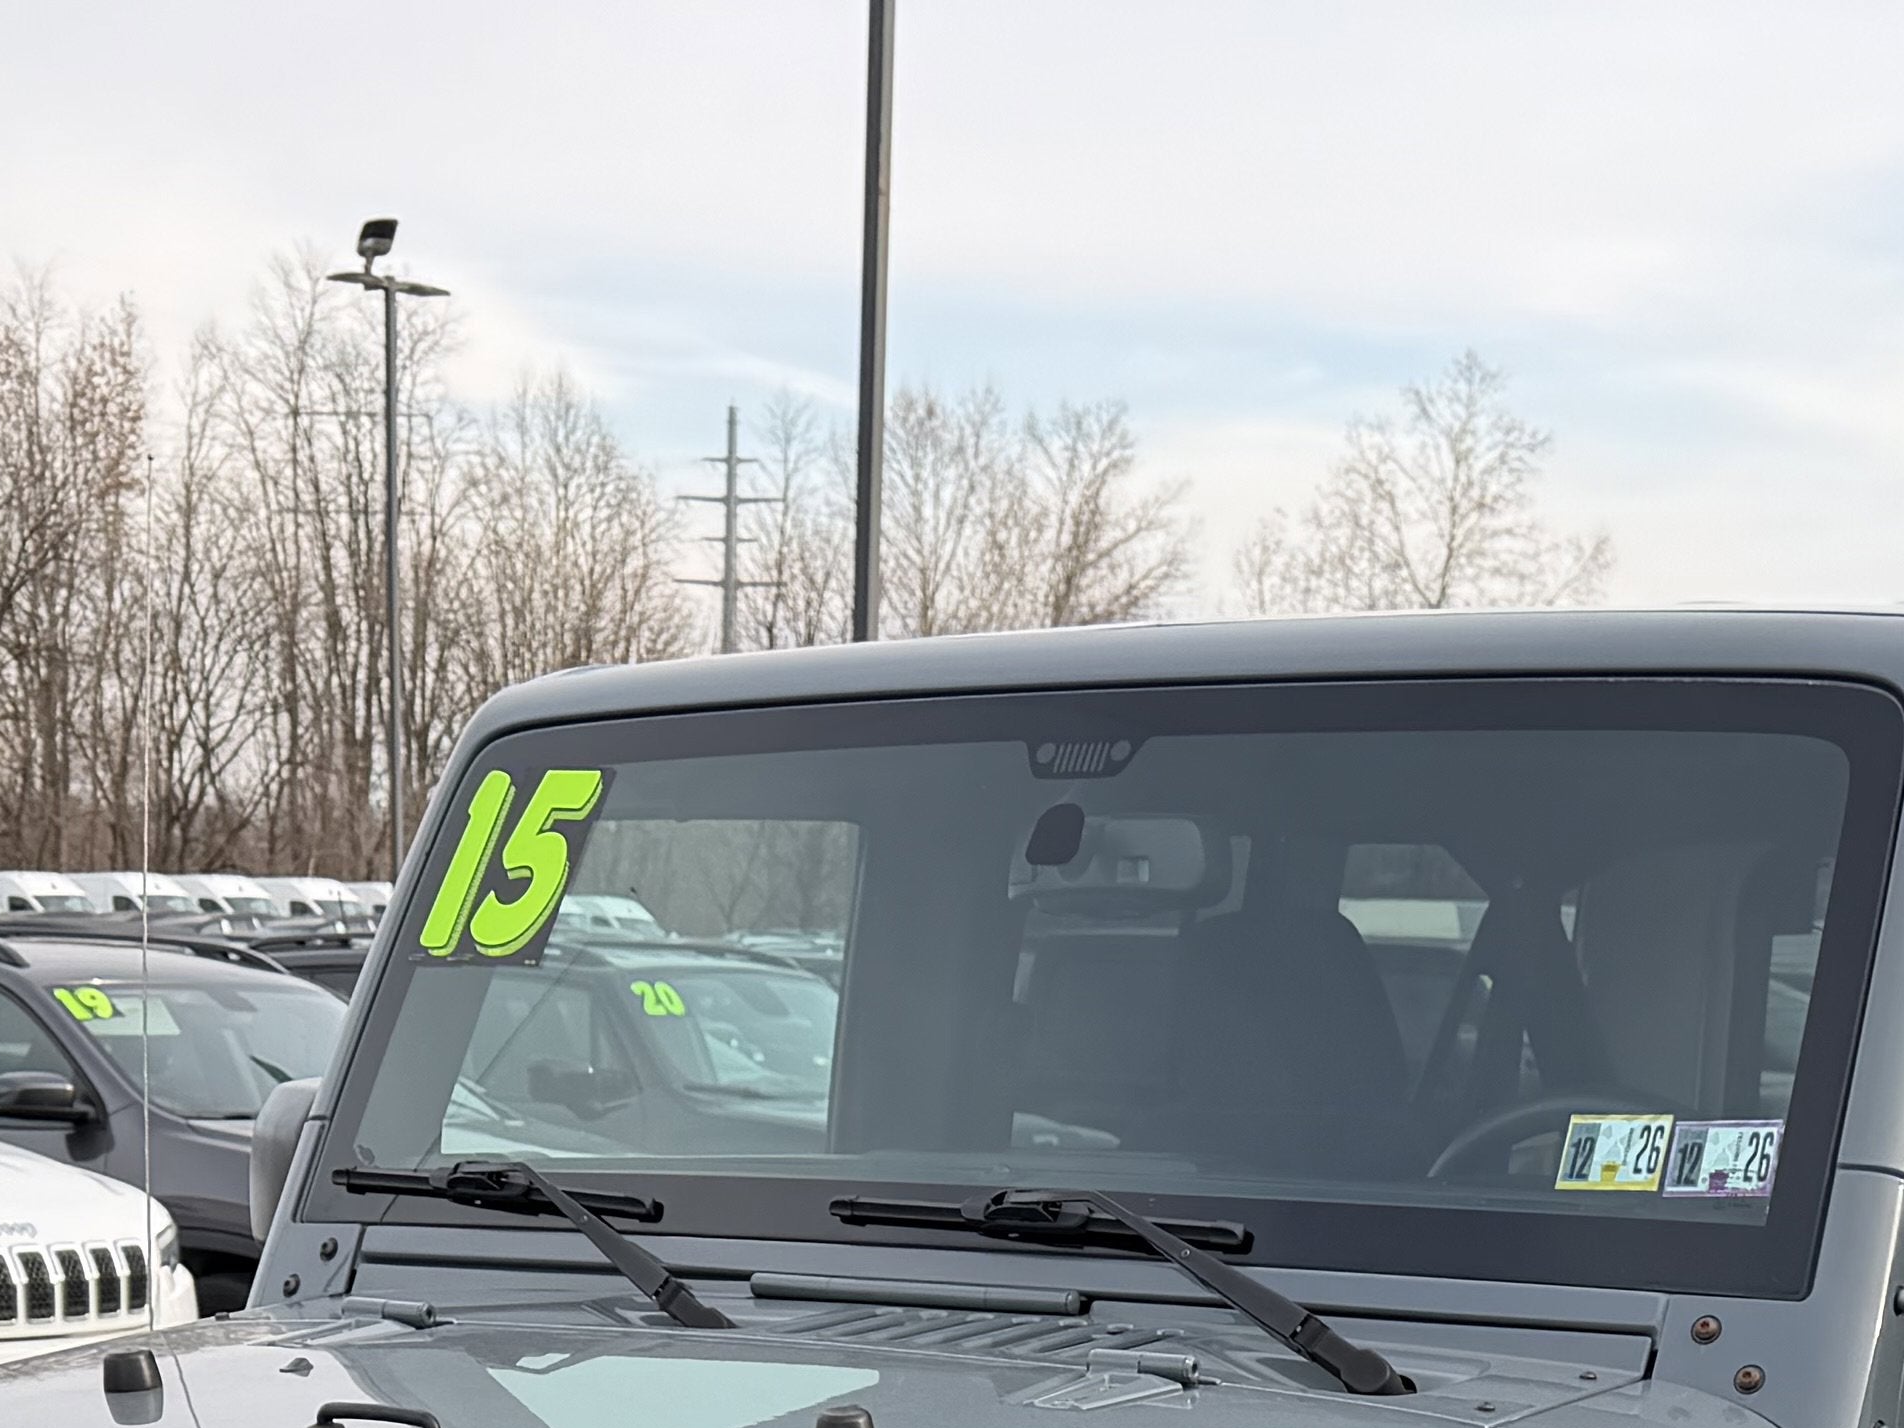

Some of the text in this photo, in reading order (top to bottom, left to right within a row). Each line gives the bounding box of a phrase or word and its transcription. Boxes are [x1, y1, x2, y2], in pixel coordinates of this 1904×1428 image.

[420, 769, 603, 957] 15
[52, 987, 113, 1020] 19
[630, 980, 685, 1017] 20
[1569, 1136, 1596, 1180] 12
[1632, 1124, 1665, 1175] 26
[1676, 1141, 1703, 1185] 12
[1743, 1131, 1775, 1183] 26
